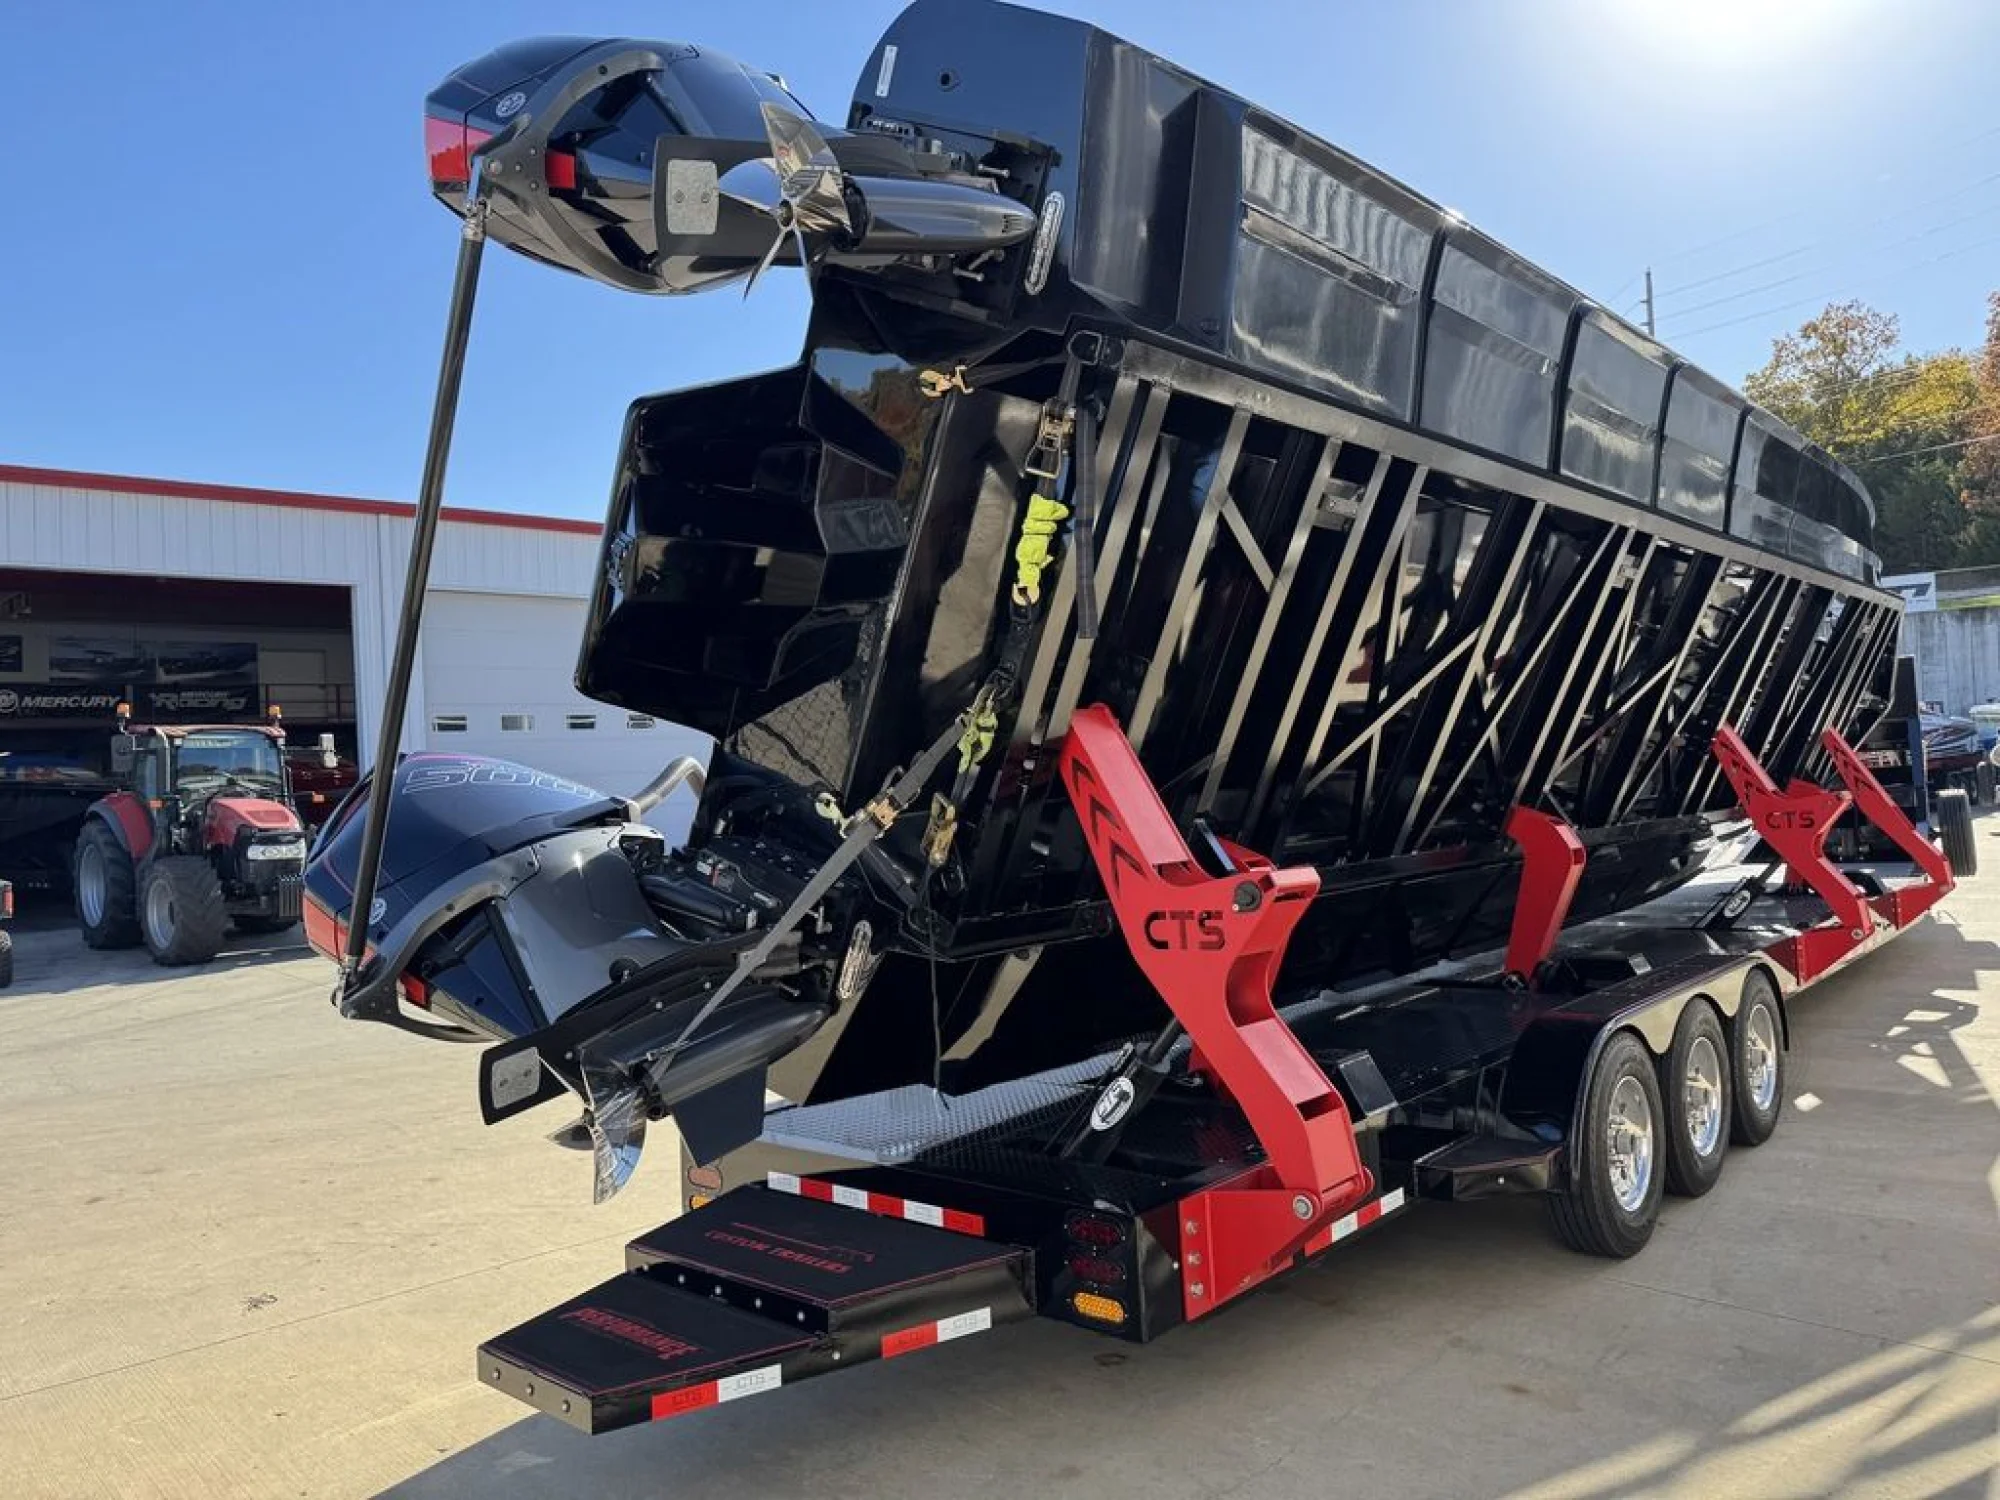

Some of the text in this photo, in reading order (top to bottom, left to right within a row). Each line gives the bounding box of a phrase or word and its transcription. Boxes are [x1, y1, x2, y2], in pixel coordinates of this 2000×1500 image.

[21, 695, 120, 708] MERCURY
[1765, 809, 1815, 830] CTS
[1144, 910, 1226, 950] CTS
